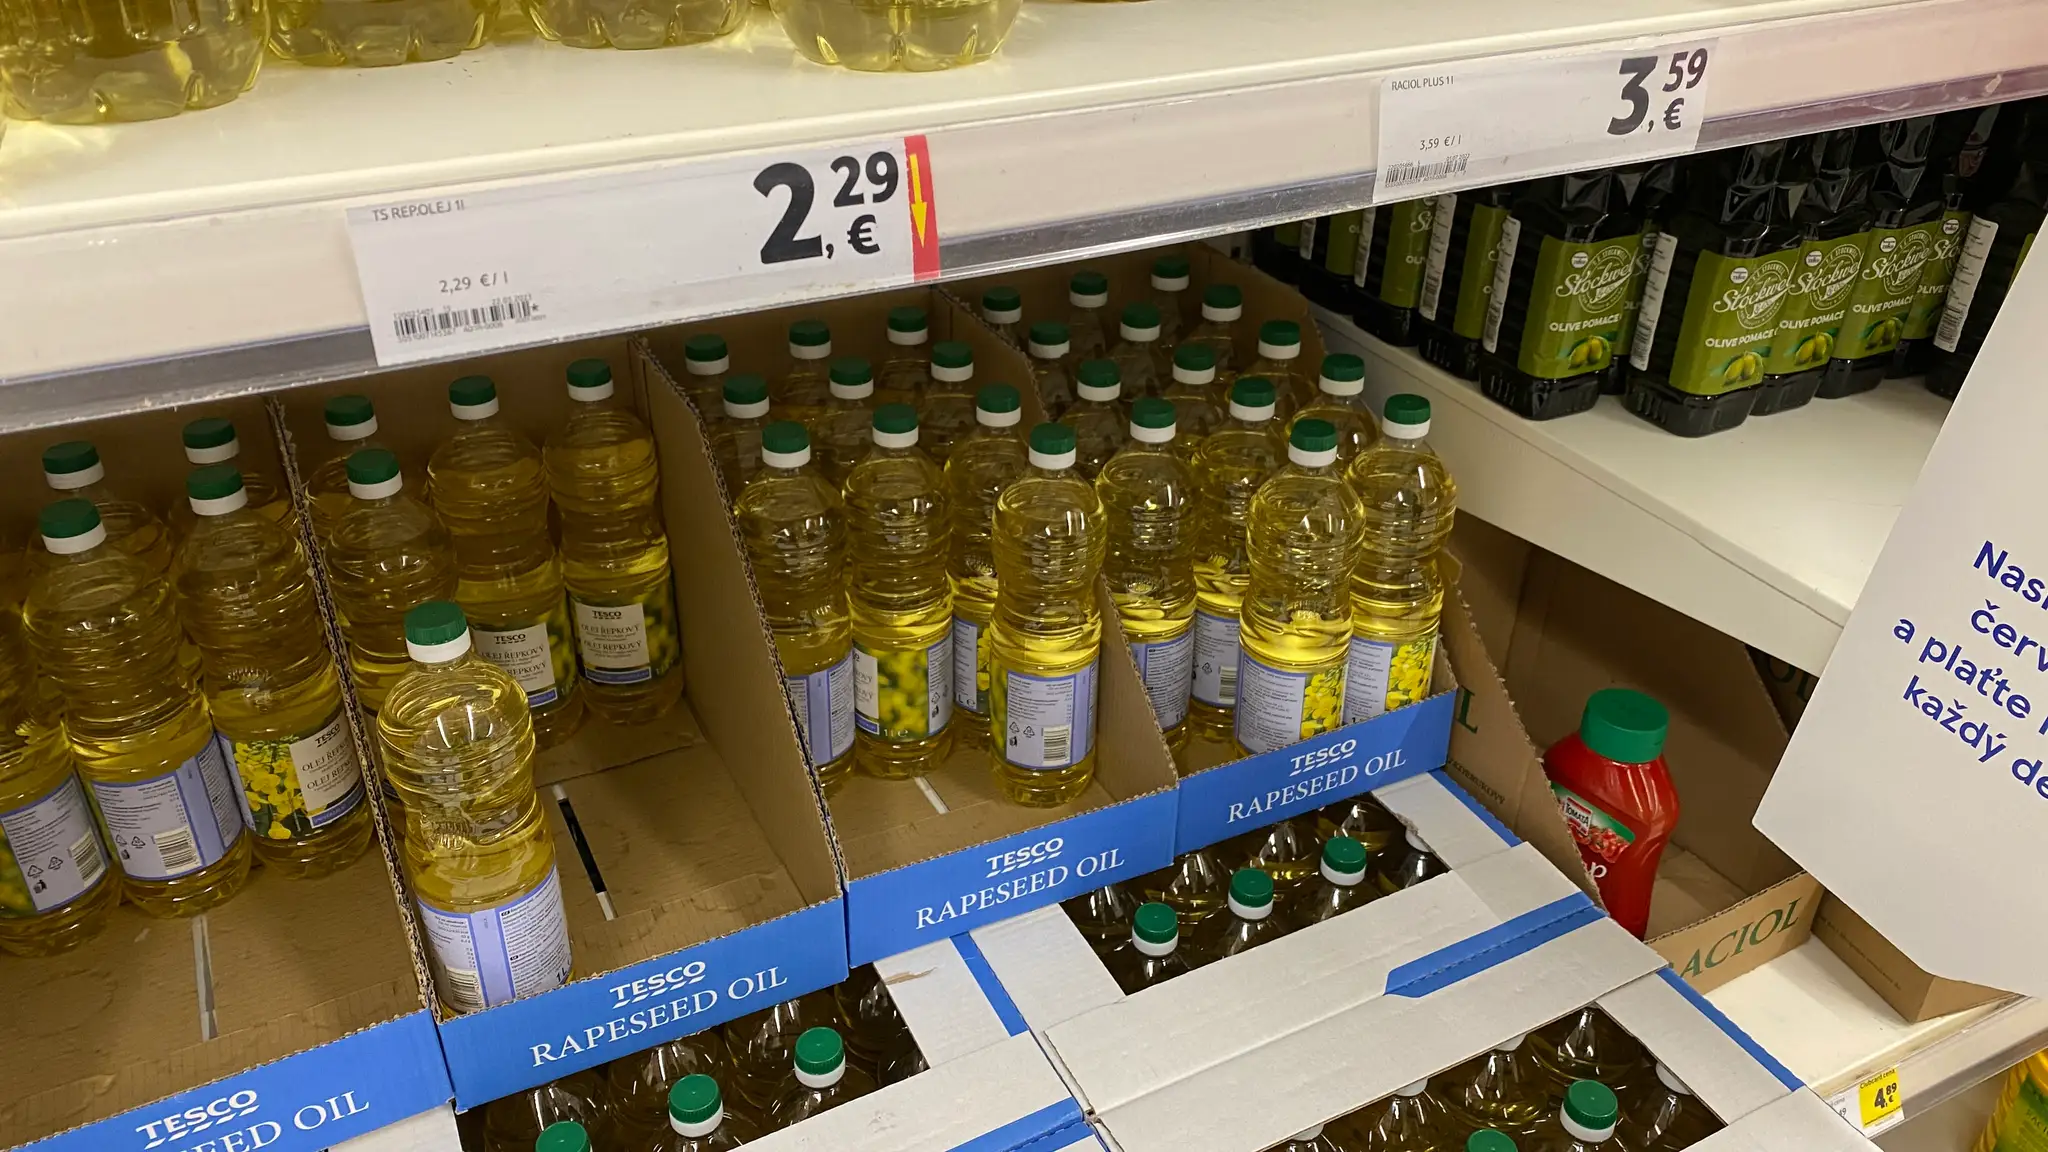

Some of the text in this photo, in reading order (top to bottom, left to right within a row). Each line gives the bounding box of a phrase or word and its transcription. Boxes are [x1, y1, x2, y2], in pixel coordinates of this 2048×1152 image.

[1391, 78, 1421, 91] RACIOL
[1422, 76, 1445, 88] PLUS
[1419, 137, 1440, 152] 3,59
[372, 208, 389, 222] TS
[438, 276, 472, 295] 2,29
[1556, 248, 1638, 300] Stockwel
[1713, 262, 1796, 314] Stockwel
[1788, 252, 1864, 296] Stockwel
[1550, 314, 1620, 332] OLIVE POMACE
[1779, 311, 1845, 330] OLIVE POMACE
[1853, 303, 1883, 313] OLIVE
[1705, 330, 1773, 348] OLIVE POMACE
[1973, 540, 2048, 610] Nas
[592, 610, 622, 618] TESCO
[494, 633, 526, 643] TESCO
[1893, 618, 2032, 720] a plaťte
[315, 723, 341, 746] TESCO
[1902, 674, 2008, 763] každý
[302, 755, 325, 772] OLEJ
[1290, 739, 1357, 771] TESCO
[307, 774, 329, 790] OLEJ
[1227, 749, 1407, 824] RAPESEED OIL
[986, 837, 1064, 873] TESCO
[915, 848, 1125, 930] RAPESEED OIL
[1669, 896, 1802, 979] ACIOL
[609, 961, 706, 1003] TESCO
[529, 966, 788, 1068] RAPESEED OIL
[1860, 1073, 1883, 1090] Clubcard
[1883, 1068, 1896, 1079] cena
[135, 1090, 259, 1144] TESCO
[293, 1090, 370, 1131] OIL
